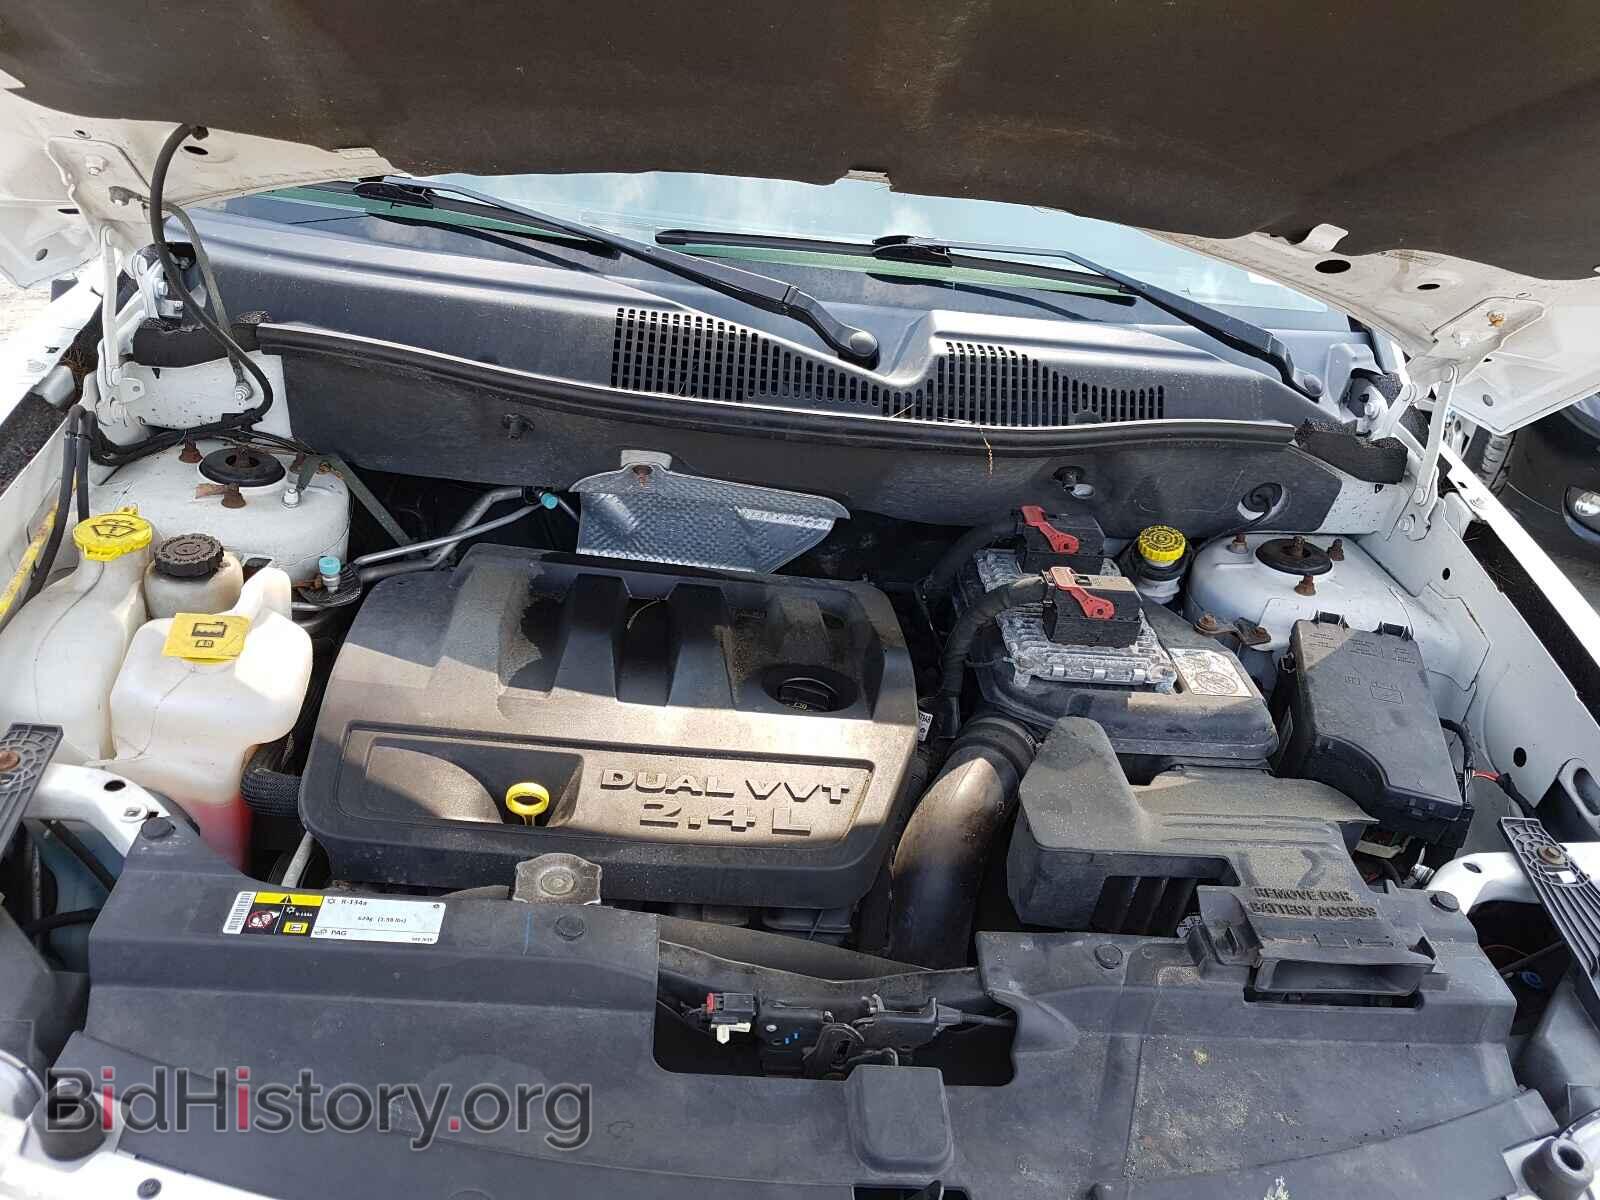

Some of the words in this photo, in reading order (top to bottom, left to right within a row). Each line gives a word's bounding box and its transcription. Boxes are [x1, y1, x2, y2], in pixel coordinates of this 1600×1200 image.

[600, 768, 735, 799] DUAL
[745, 779, 850, 805] VVT
[639, 799, 812, 837] 2.4L
[1253, 888, 1319, 902] REMOVE
[1320, 891, 1354, 903] FOR
[1249, 902, 1313, 917] BATTERY
[1318, 905, 1378, 919] ACCESS
